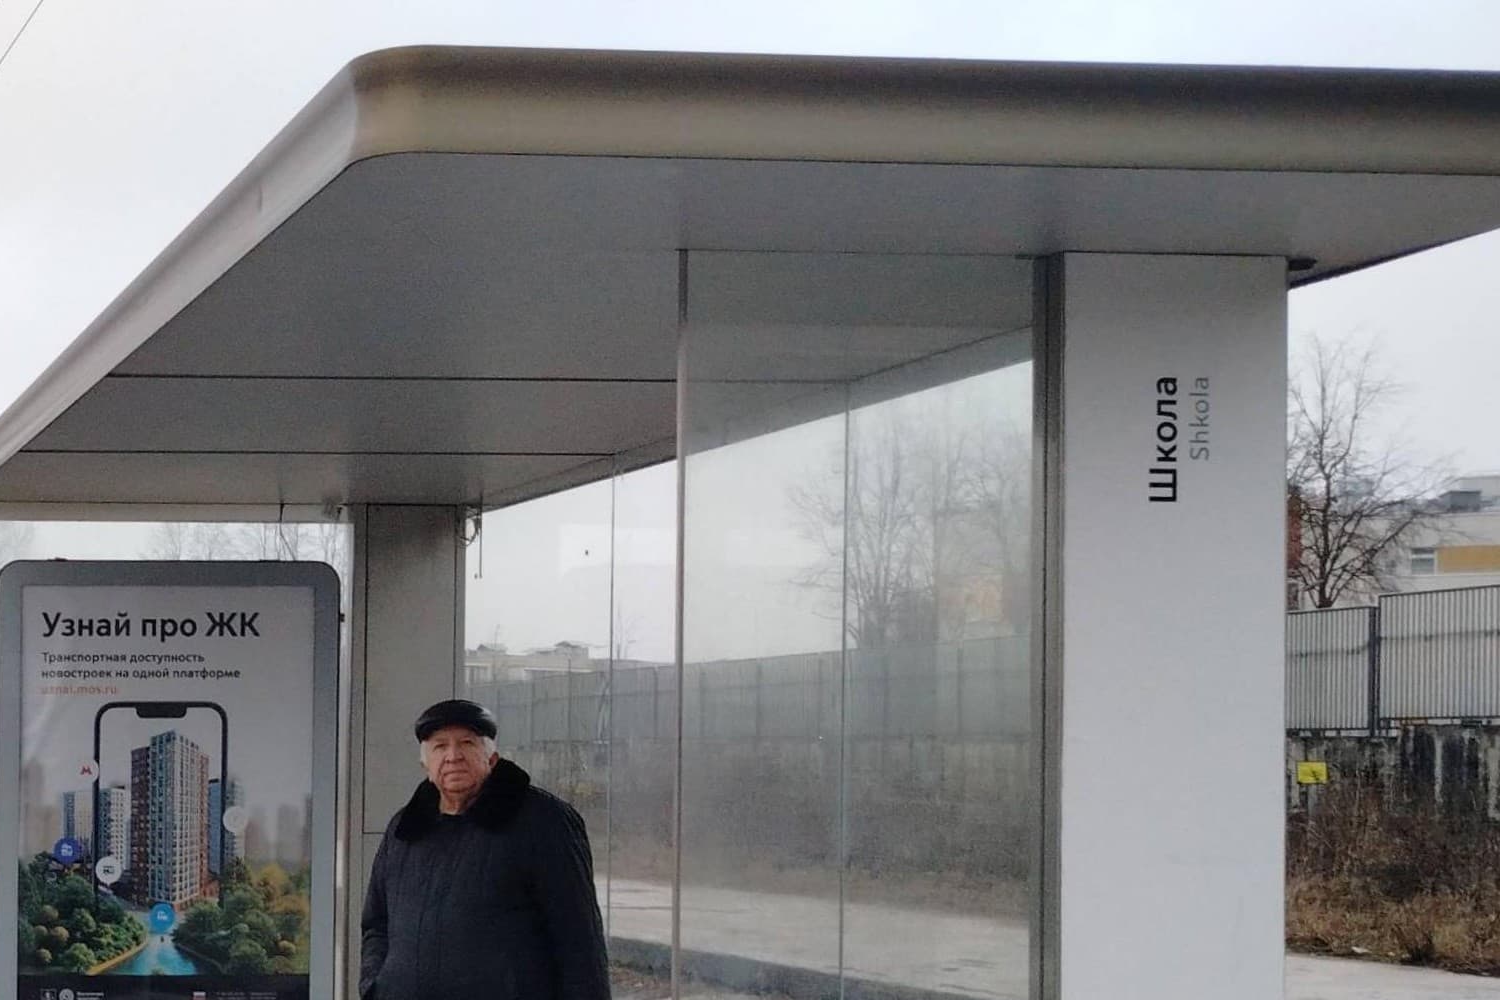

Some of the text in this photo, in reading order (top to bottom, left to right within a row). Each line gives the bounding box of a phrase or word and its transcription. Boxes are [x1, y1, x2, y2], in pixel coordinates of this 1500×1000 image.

[1188, 377, 1210, 461] Shkola
[1148, 376, 1178, 502] Школа
[41, 611, 260, 643] Узнай про ЖК
[41, 652, 205, 665] Транспортная доступность
[41, 667, 241, 680] новостроек на одной платформе
